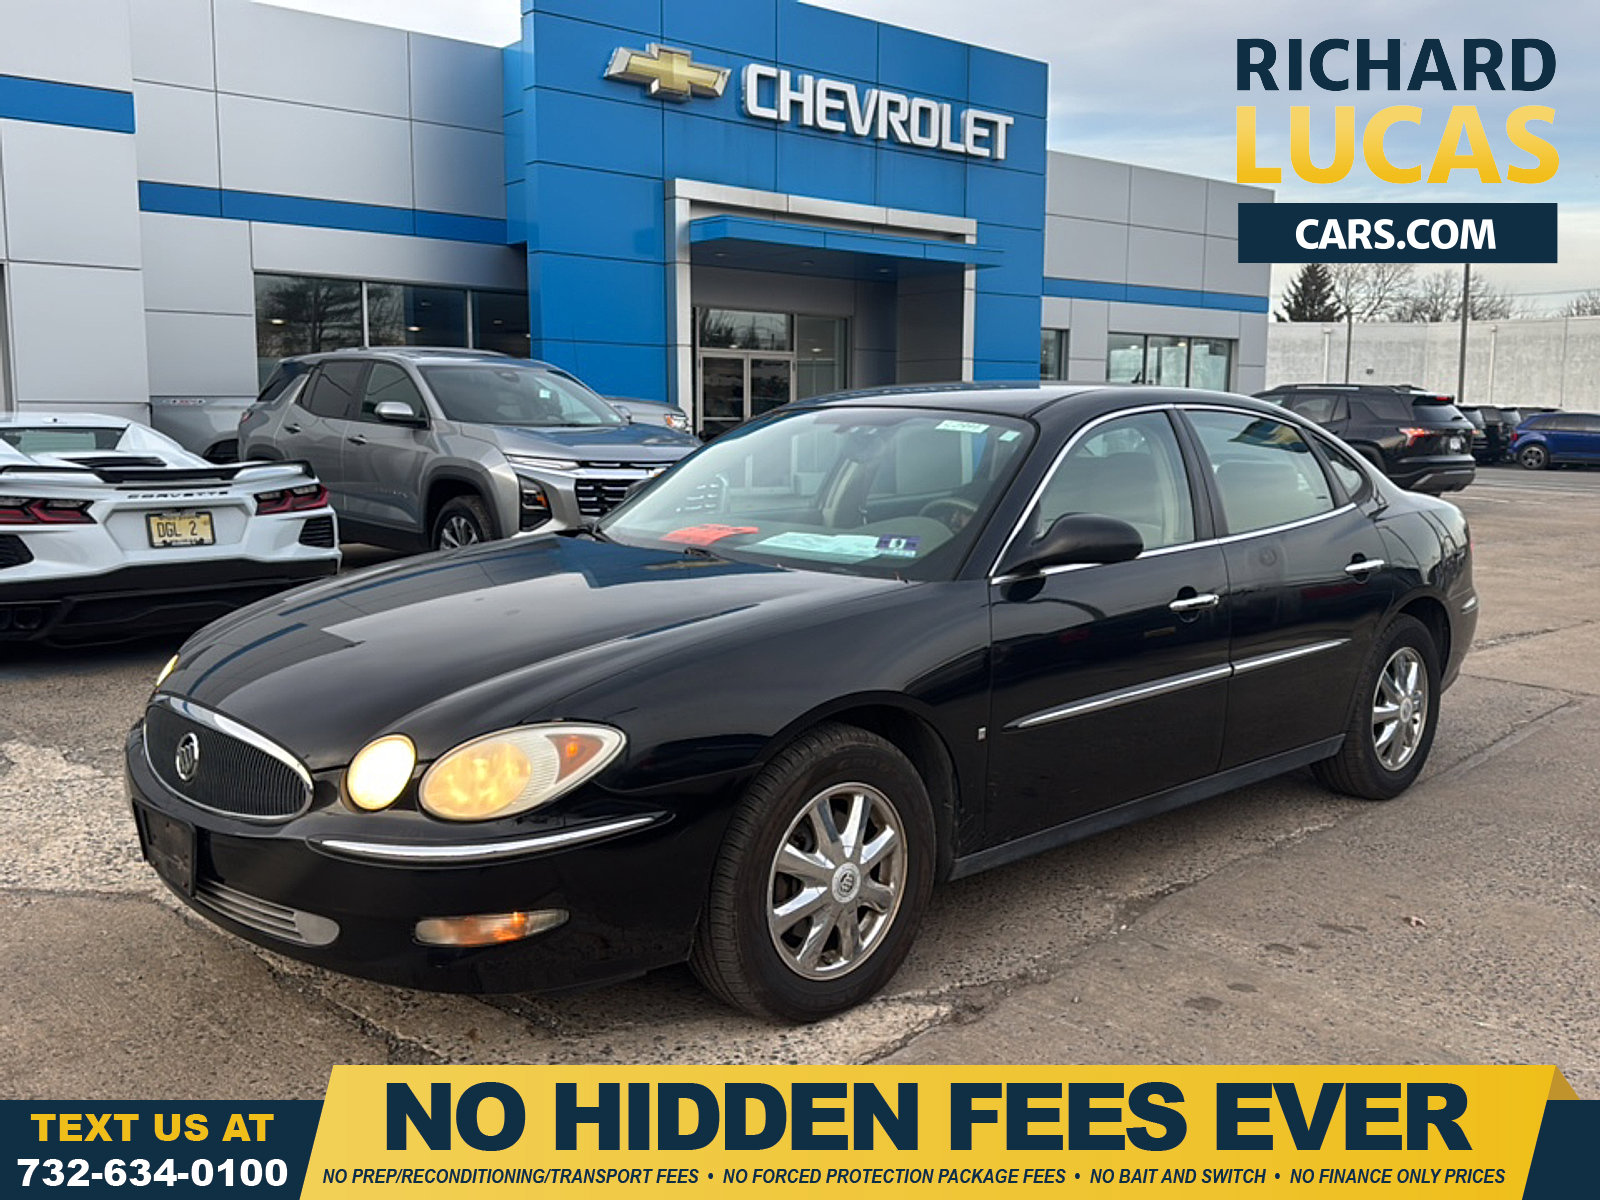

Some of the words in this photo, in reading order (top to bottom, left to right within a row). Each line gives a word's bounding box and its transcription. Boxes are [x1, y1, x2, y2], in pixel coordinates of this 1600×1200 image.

[741, 63, 1014, 160] CHEVROLET
[127, 491, 229, 499] CORVETTE
[157, 521, 182, 538] DGL
[188, 520, 198, 536] 2
